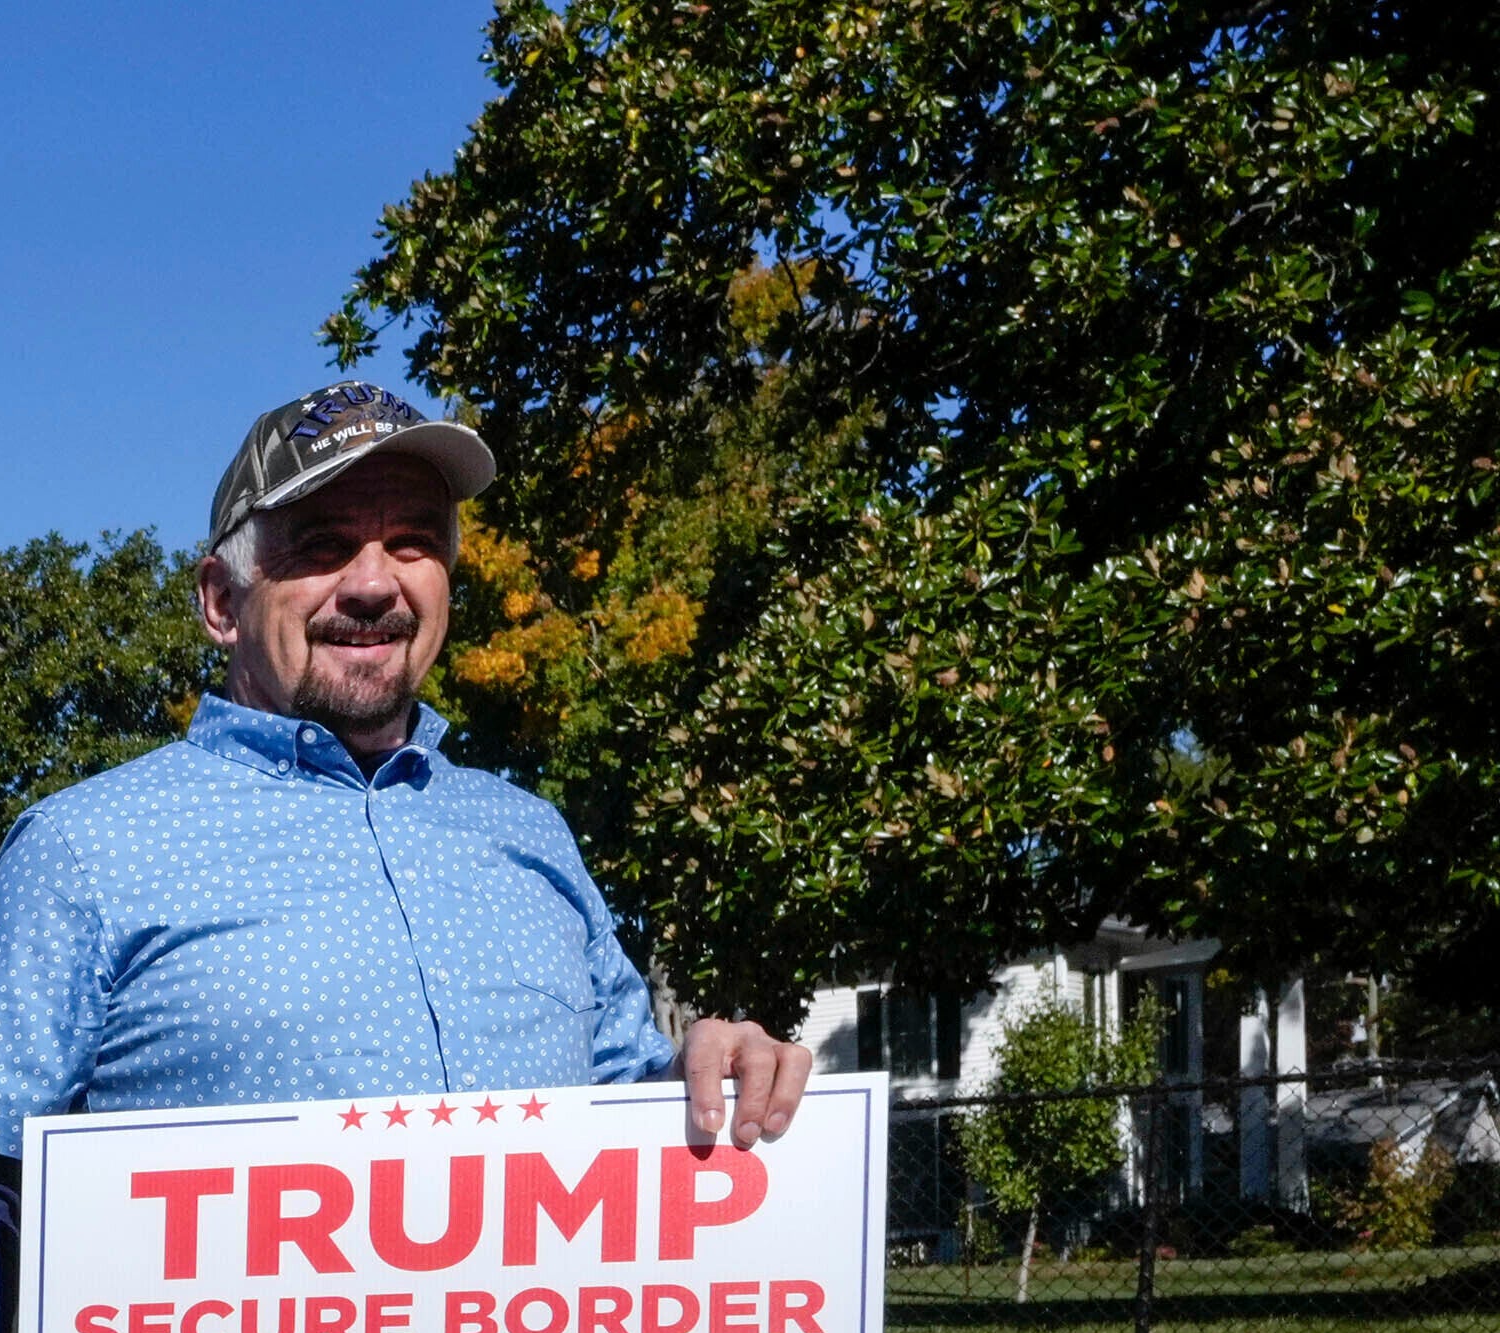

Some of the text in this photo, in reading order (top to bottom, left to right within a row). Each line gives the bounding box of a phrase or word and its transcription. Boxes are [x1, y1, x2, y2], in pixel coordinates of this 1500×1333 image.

[285, 384, 426, 441] TRUM
[311, 437, 332, 452] HE
[333, 423, 372, 442] WILL
[131, 1145, 768, 1281] TRUMP
